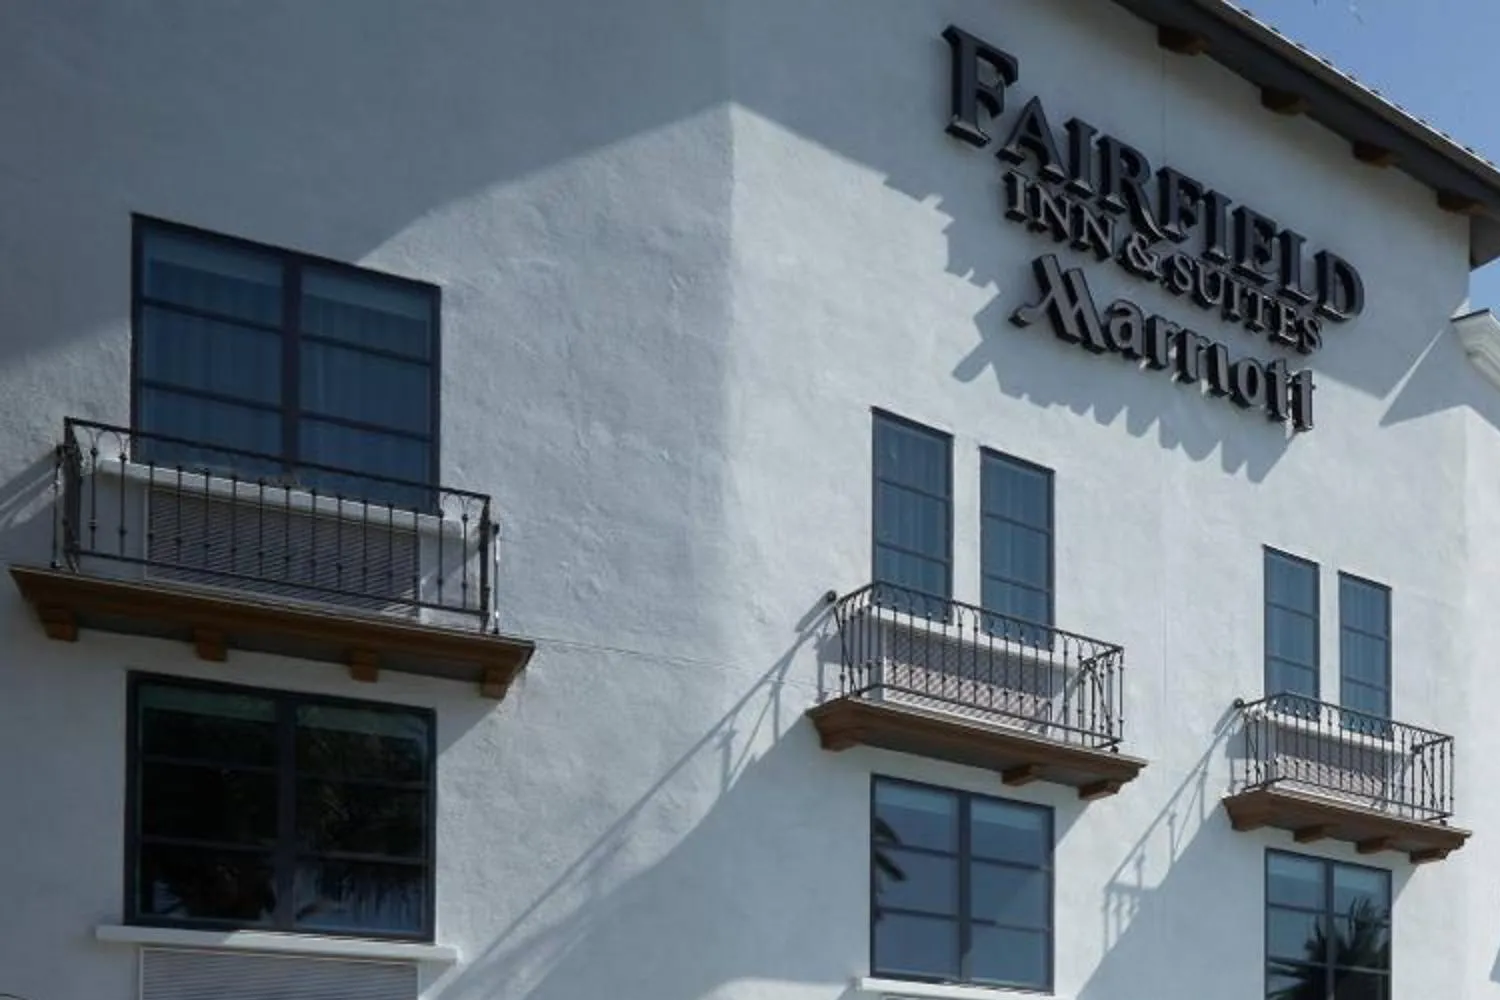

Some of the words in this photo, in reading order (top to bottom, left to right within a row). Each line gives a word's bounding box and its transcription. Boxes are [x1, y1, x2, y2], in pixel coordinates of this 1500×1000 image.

[942, 25, 1365, 322] FAIRFIELD
[1002, 169, 1118, 262] INN
[1119, 230, 1162, 280] &
[1167, 248, 1324, 355] SUITES
[1009, 253, 1316, 432] Marriott
